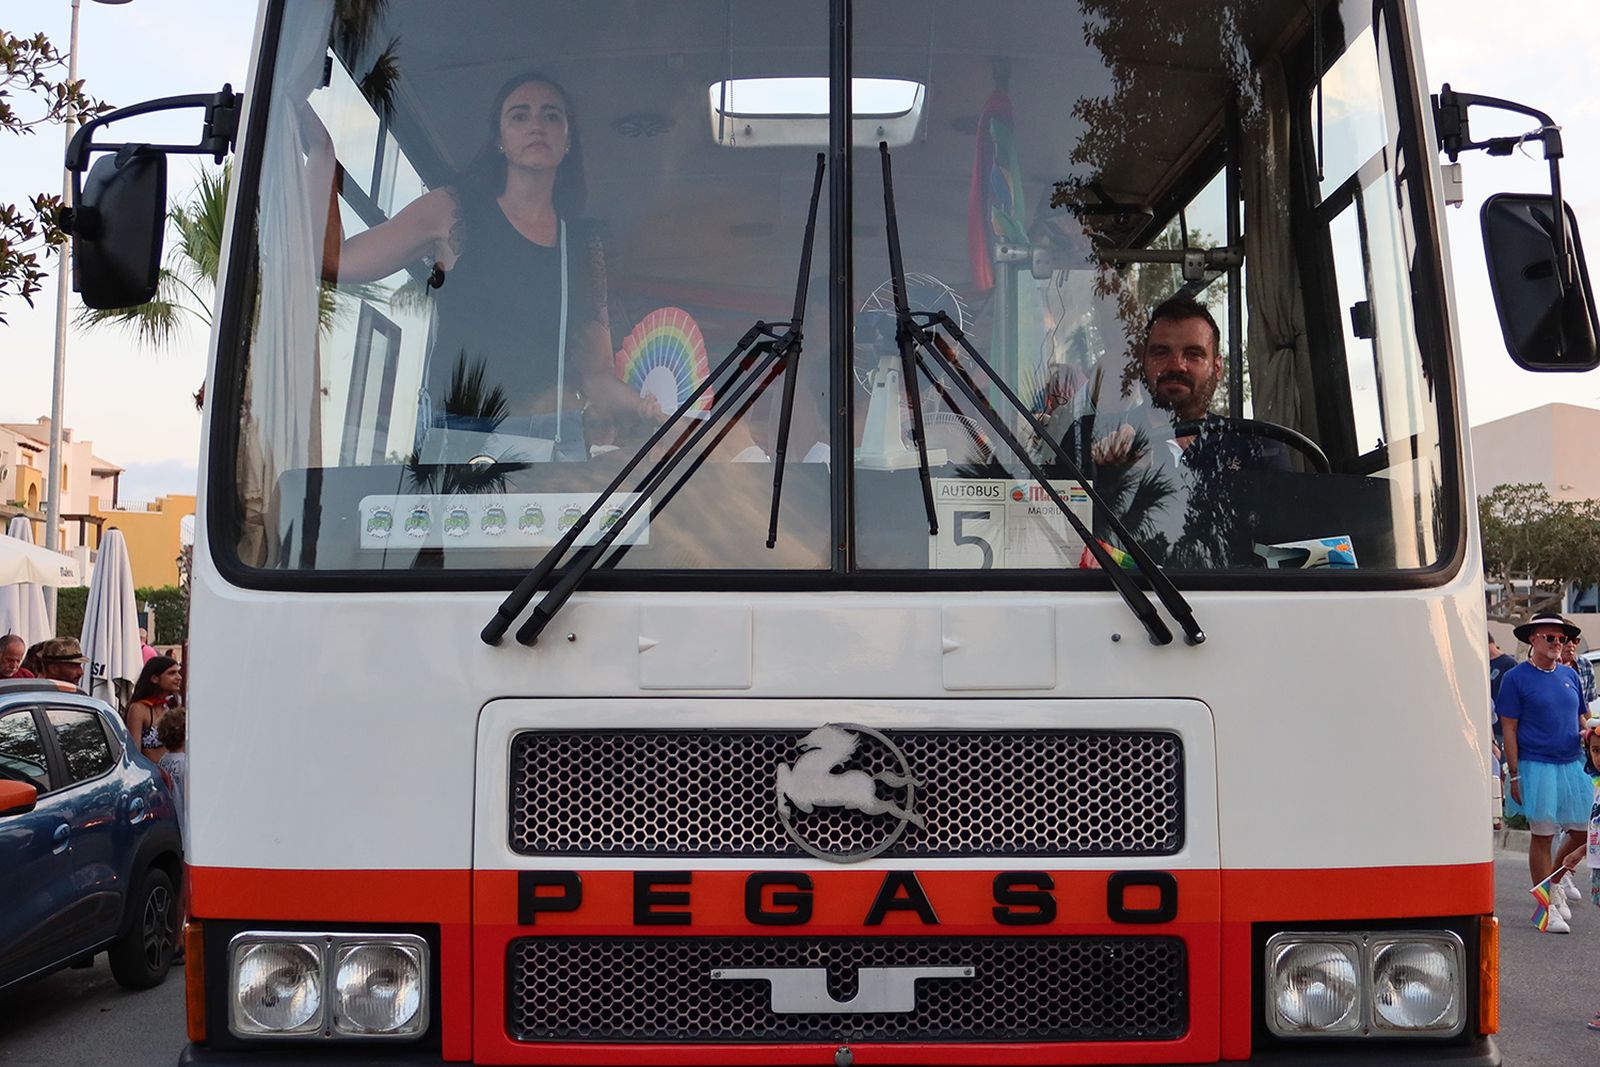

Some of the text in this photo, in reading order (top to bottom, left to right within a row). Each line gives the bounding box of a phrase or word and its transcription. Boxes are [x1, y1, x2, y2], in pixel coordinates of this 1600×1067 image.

[941, 485, 1000, 497] AUTOBUS
[953, 511, 994, 570] 5
[517, 870, 1179, 926] PEGASO
